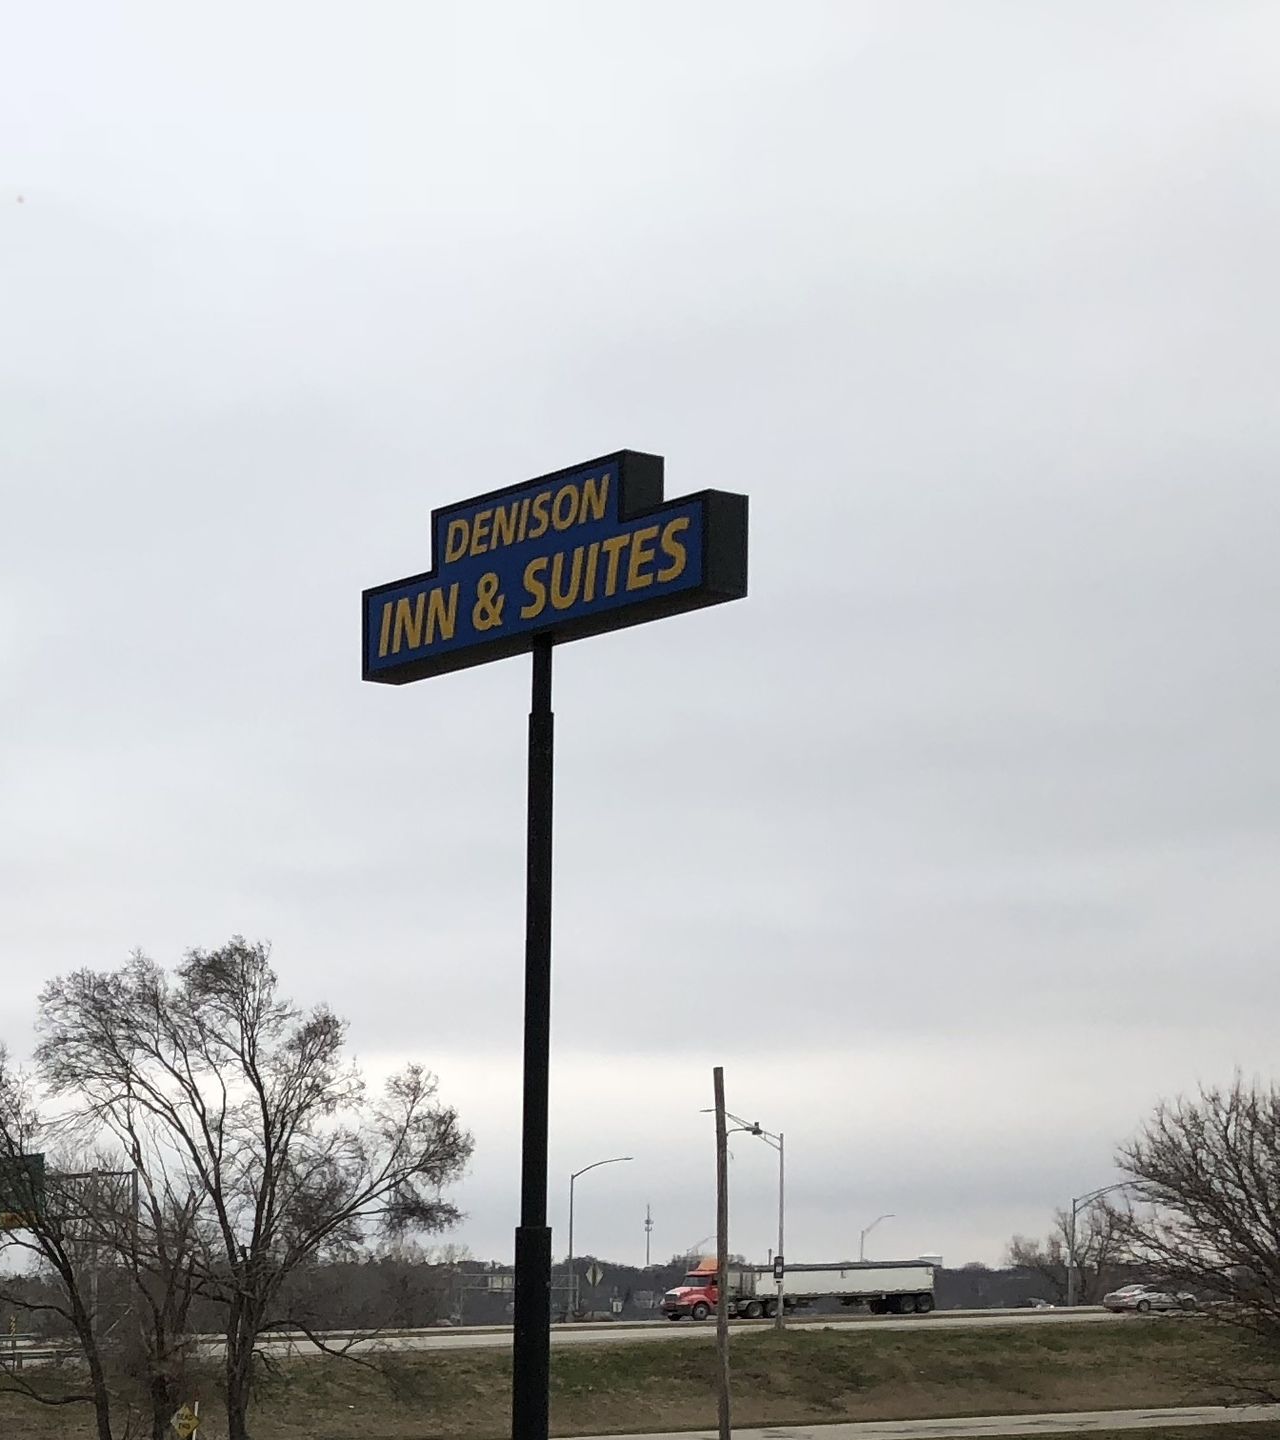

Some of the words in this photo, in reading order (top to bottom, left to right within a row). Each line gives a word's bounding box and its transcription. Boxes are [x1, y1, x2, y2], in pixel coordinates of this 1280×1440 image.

[444, 473, 611, 564] DENISON
[378, 582, 459, 657] INN
[472, 572, 506, 631] &
[520, 517, 690, 619] SUITES
